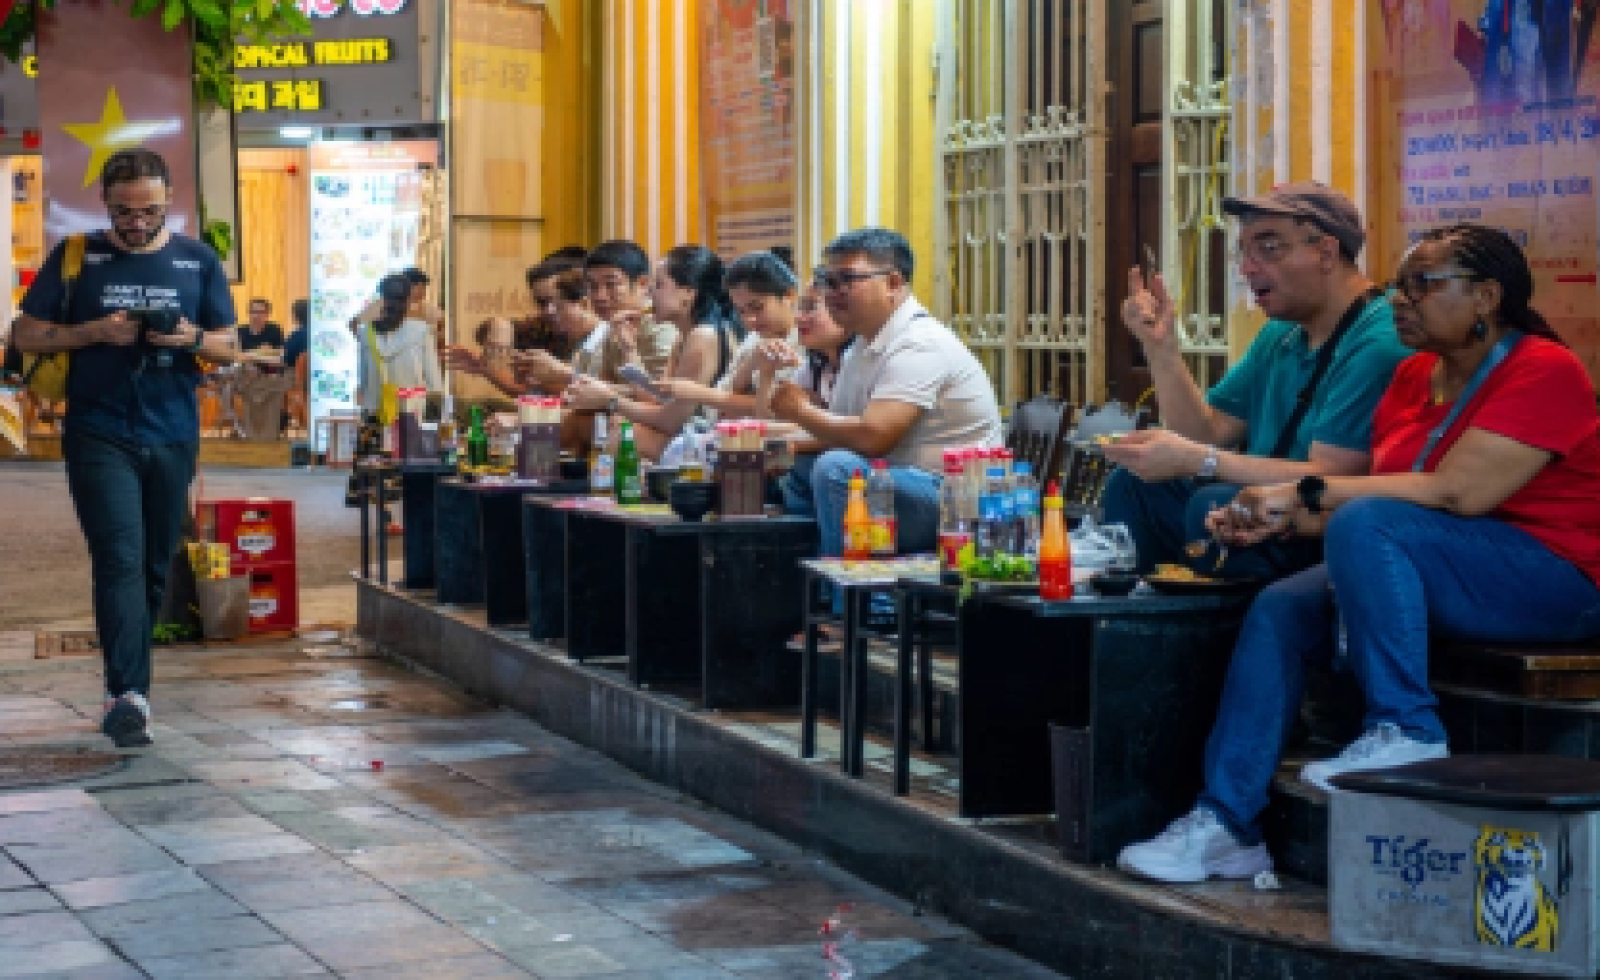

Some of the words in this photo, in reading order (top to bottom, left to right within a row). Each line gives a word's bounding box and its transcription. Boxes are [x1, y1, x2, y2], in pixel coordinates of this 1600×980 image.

[234, 43, 309, 68] OPICAL
[314, 38, 390, 64] FRUITS
[1365, 834, 1467, 890] Tiger
